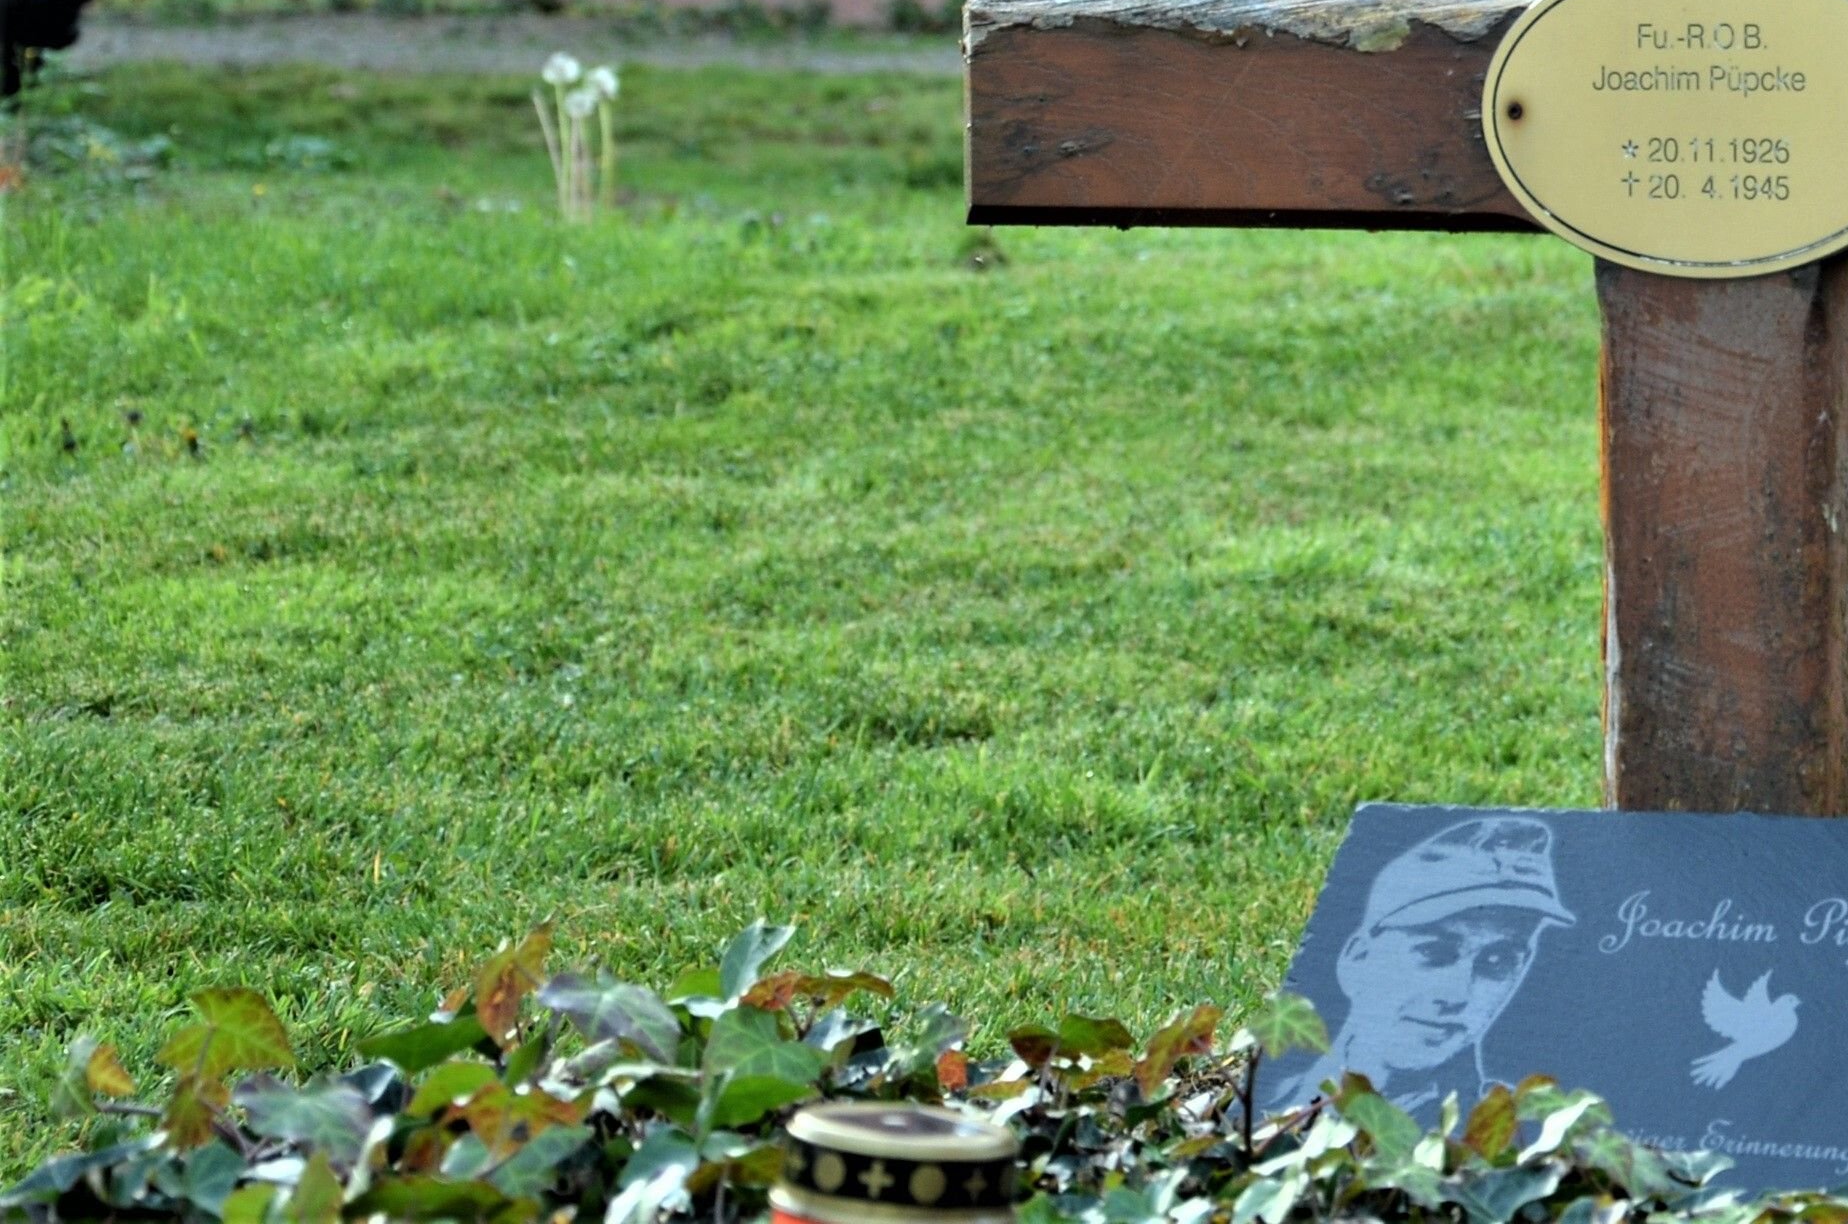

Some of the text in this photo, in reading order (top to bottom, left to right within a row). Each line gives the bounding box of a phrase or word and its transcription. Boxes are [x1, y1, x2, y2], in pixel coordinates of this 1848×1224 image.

[1592, 64, 1806, 98] Joachim Püpcke
[1648, 137, 1790, 164] 20.11.1926
[1599, 890, 1777, 954] Joachim
